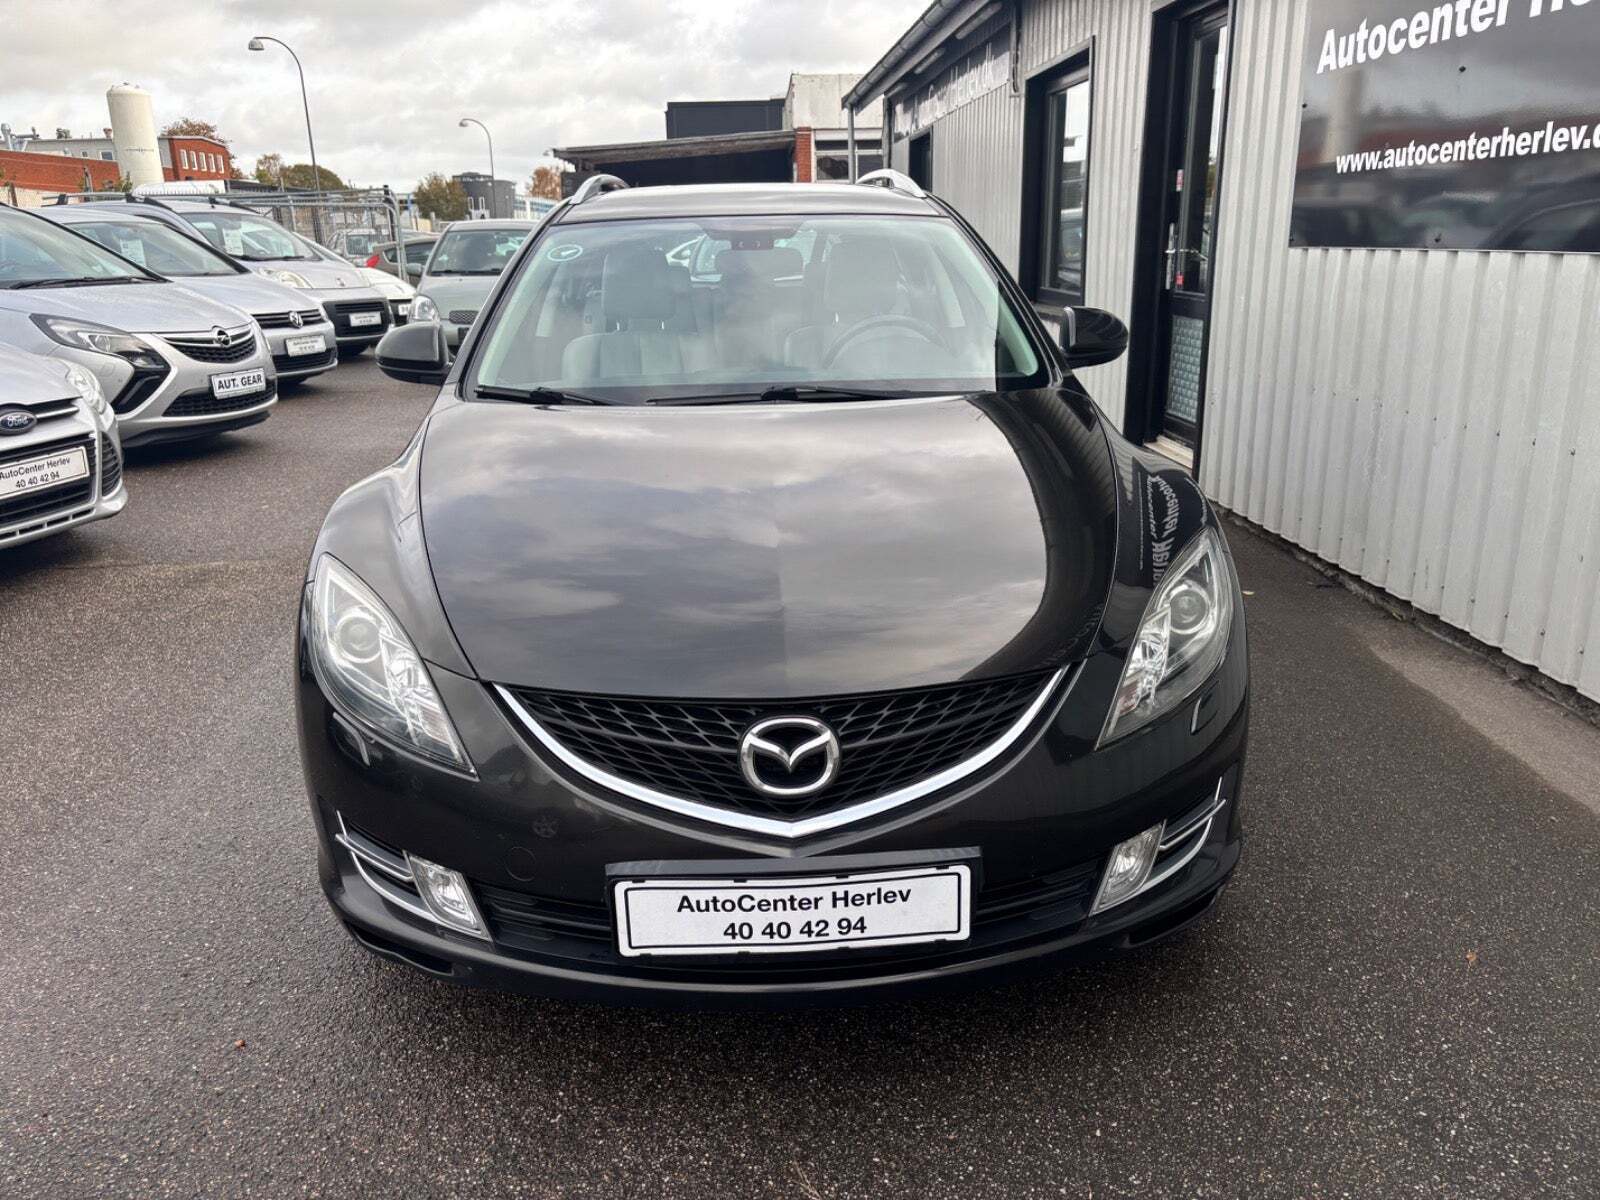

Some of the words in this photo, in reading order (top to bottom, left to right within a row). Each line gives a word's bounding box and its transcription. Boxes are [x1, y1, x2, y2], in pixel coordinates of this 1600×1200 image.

[1317, 0, 1509, 74] Autocenter
[218, 378, 239, 390] AUT.
[241, 374, 263, 386] GEAR
[0, 464, 45, 480] AutoCenter
[46, 457, 71, 469] Herlev
[28, 477, 38, 486] 40
[40, 474, 49, 483] 42
[50, 471, 60, 480] 94
[677, 894, 823, 913] AutoCenter
[831, 887, 912, 908] Herlev
[723, 922, 753, 940] 40
[761, 921, 791, 939] 40
[799, 919, 829, 938] 42
[837, 916, 867, 935] 94
